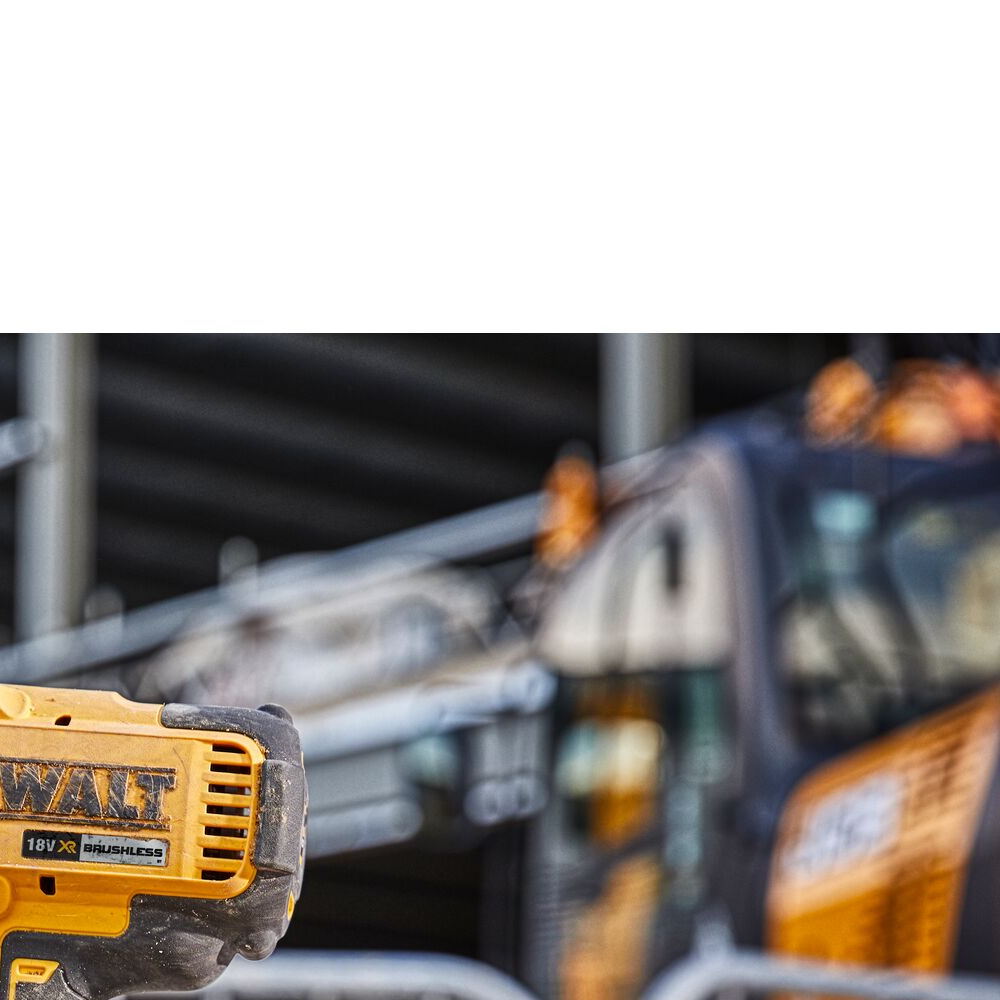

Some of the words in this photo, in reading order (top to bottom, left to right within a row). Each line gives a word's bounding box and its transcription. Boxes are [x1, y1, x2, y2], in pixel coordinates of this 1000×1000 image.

[27, 837, 56, 852] 18V
[57, 839, 77, 854] XR
[83, 843, 163, 858] BRUSHLESS
